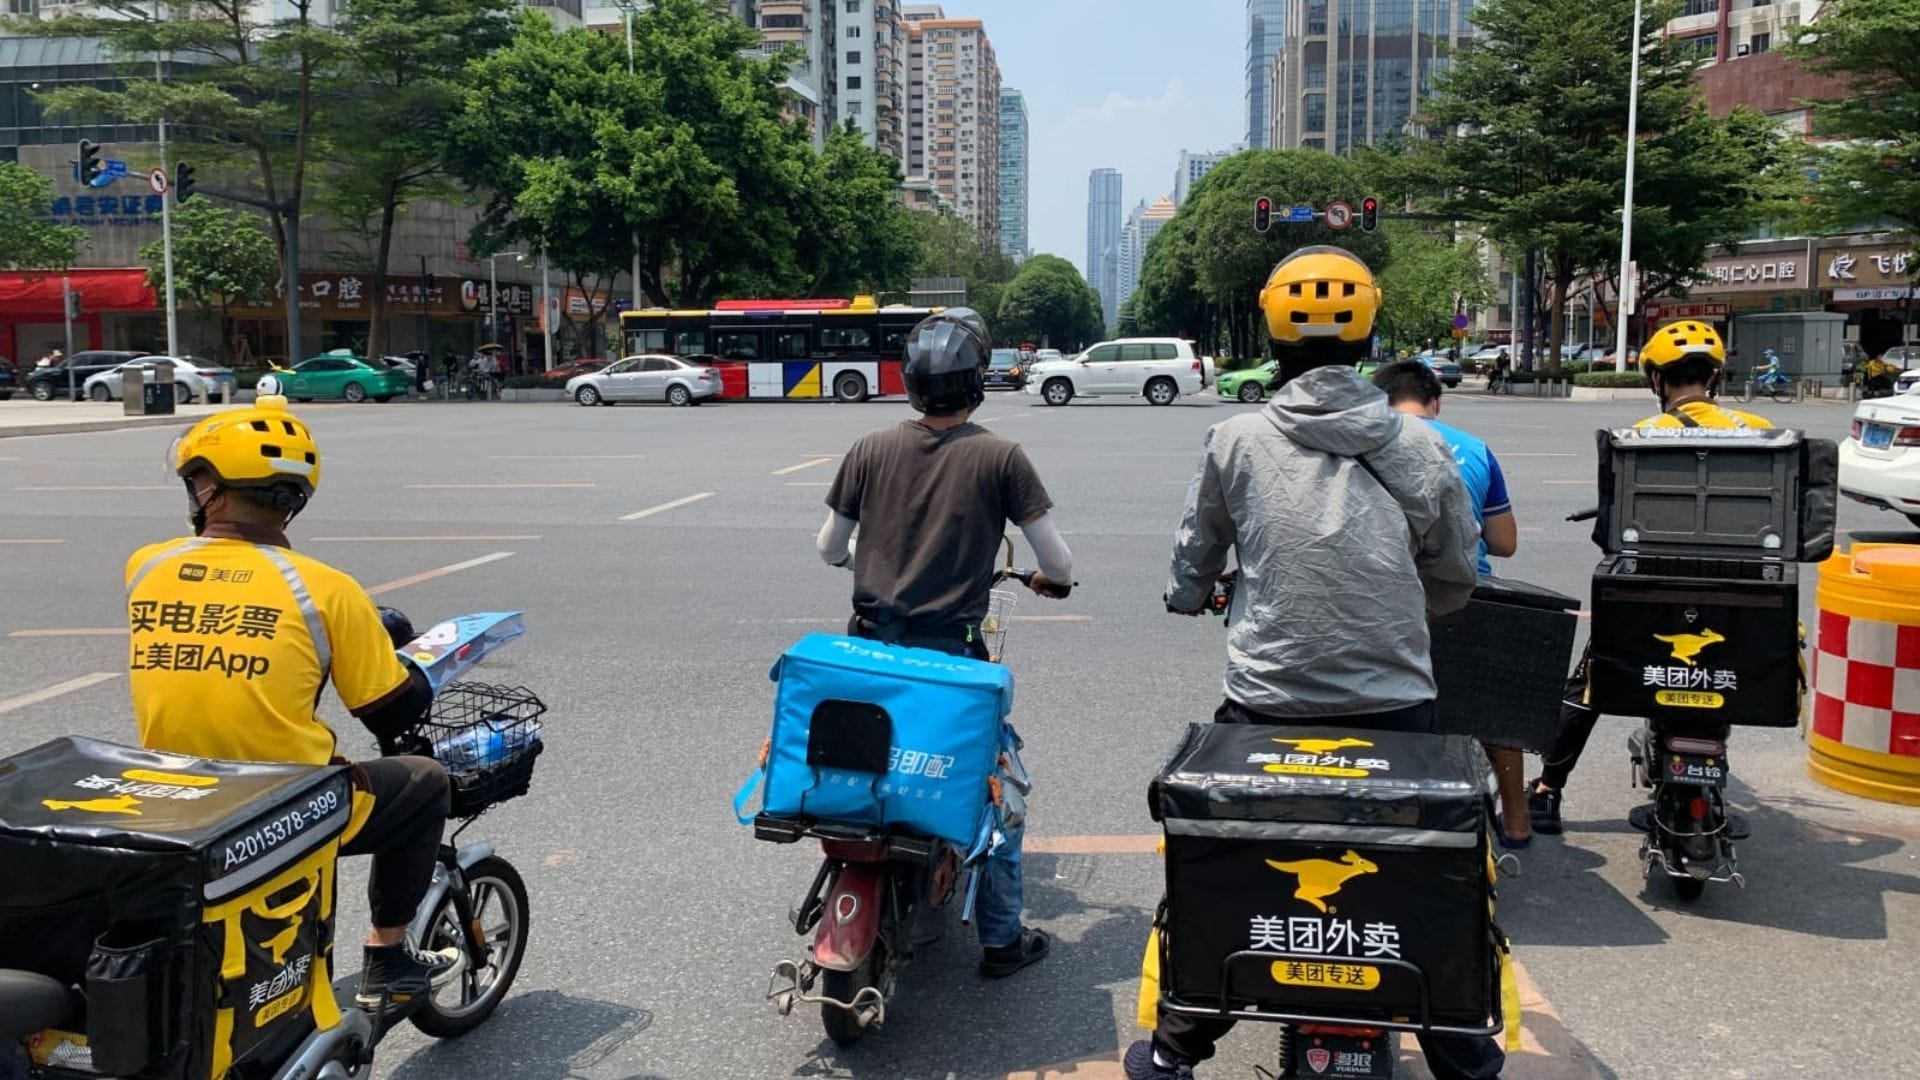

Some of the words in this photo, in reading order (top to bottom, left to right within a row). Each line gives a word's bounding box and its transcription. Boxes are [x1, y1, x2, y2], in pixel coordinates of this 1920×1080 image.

[209, 568, 254, 583] 美团
[131, 600, 283, 640] 买电影票
[1643, 664, 1738, 691] 美团外卖
[1665, 692, 1714, 705] 美团专送
[1246, 752, 1391, 770] 美团外卖
[223, 790, 337, 871] A2015378-399
[1249, 914, 1401, 959] 美团外卖
[249, 953, 312, 1012] 美团外卖
[1286, 961, 1366, 986] 美团专送
